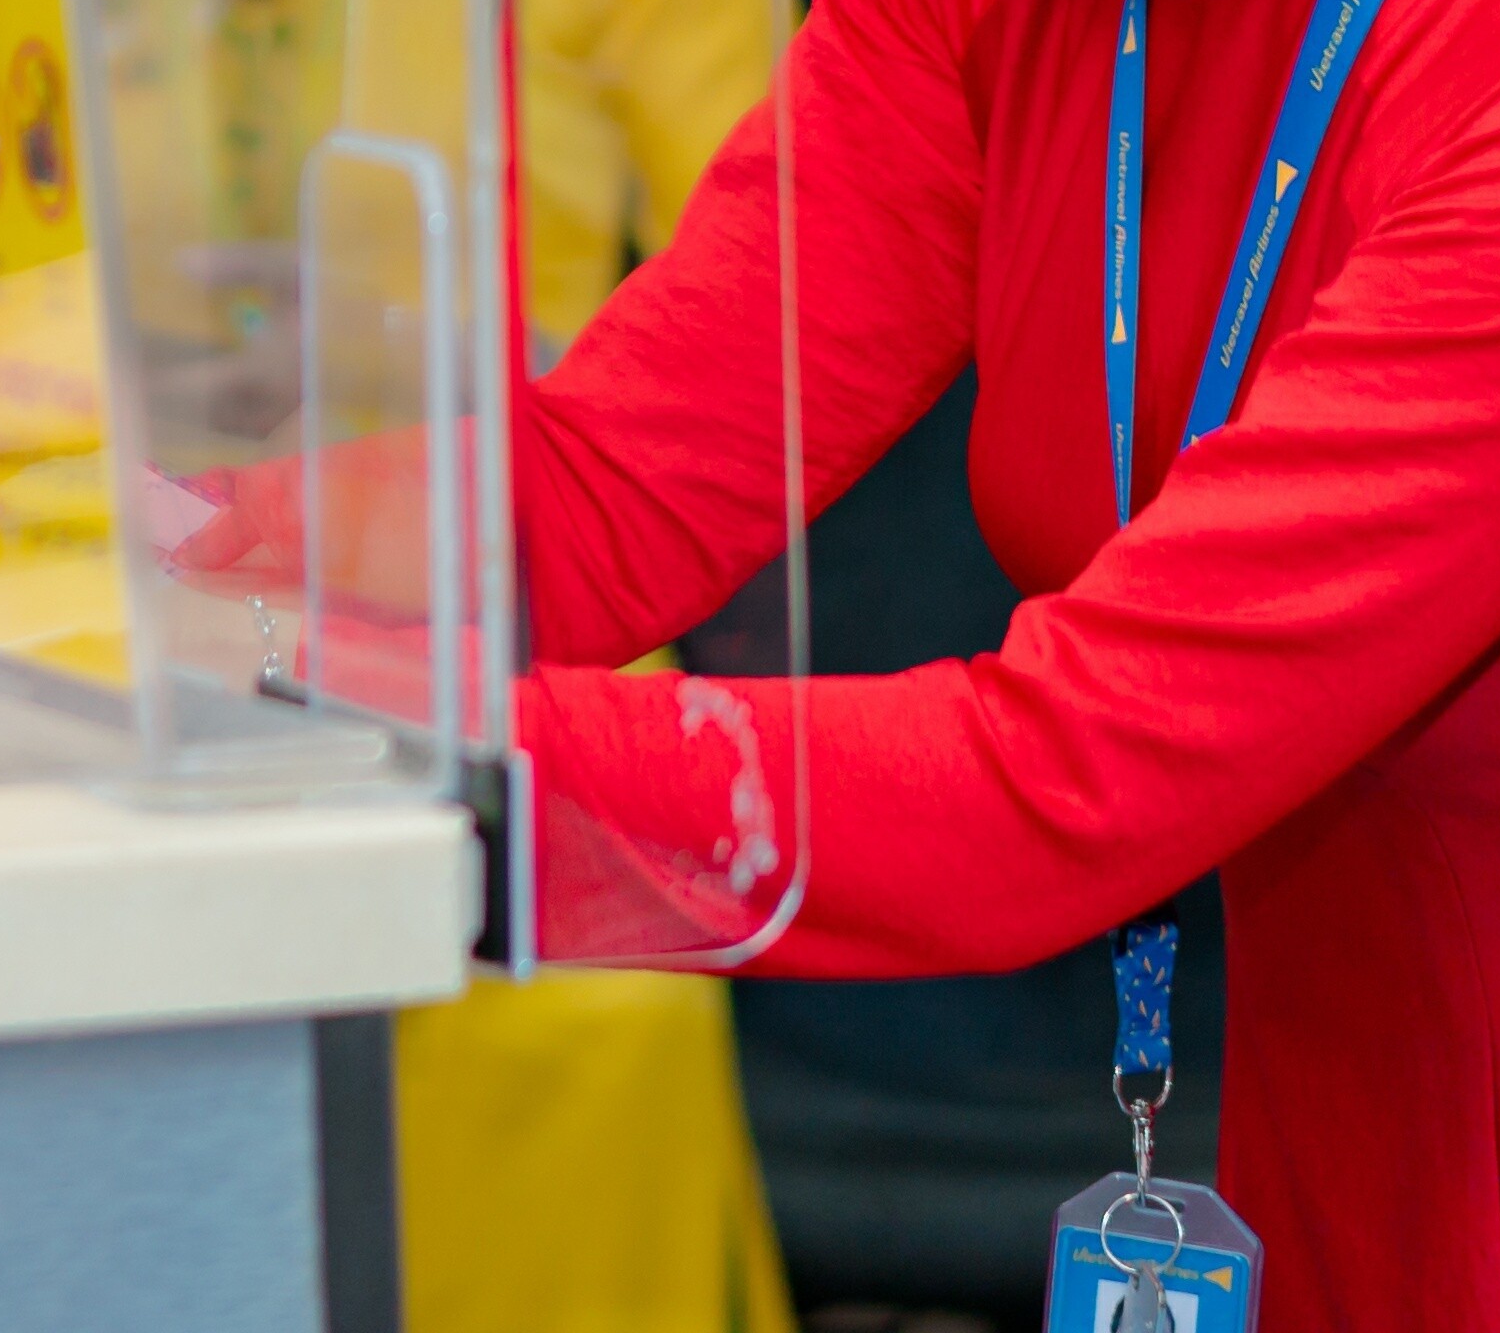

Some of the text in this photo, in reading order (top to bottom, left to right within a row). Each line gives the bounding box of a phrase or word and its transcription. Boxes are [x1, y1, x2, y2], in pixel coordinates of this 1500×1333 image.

[1310, 1, 1354, 91] Vietravel
[1220, 205, 1279, 368] Vietravel Airlines
